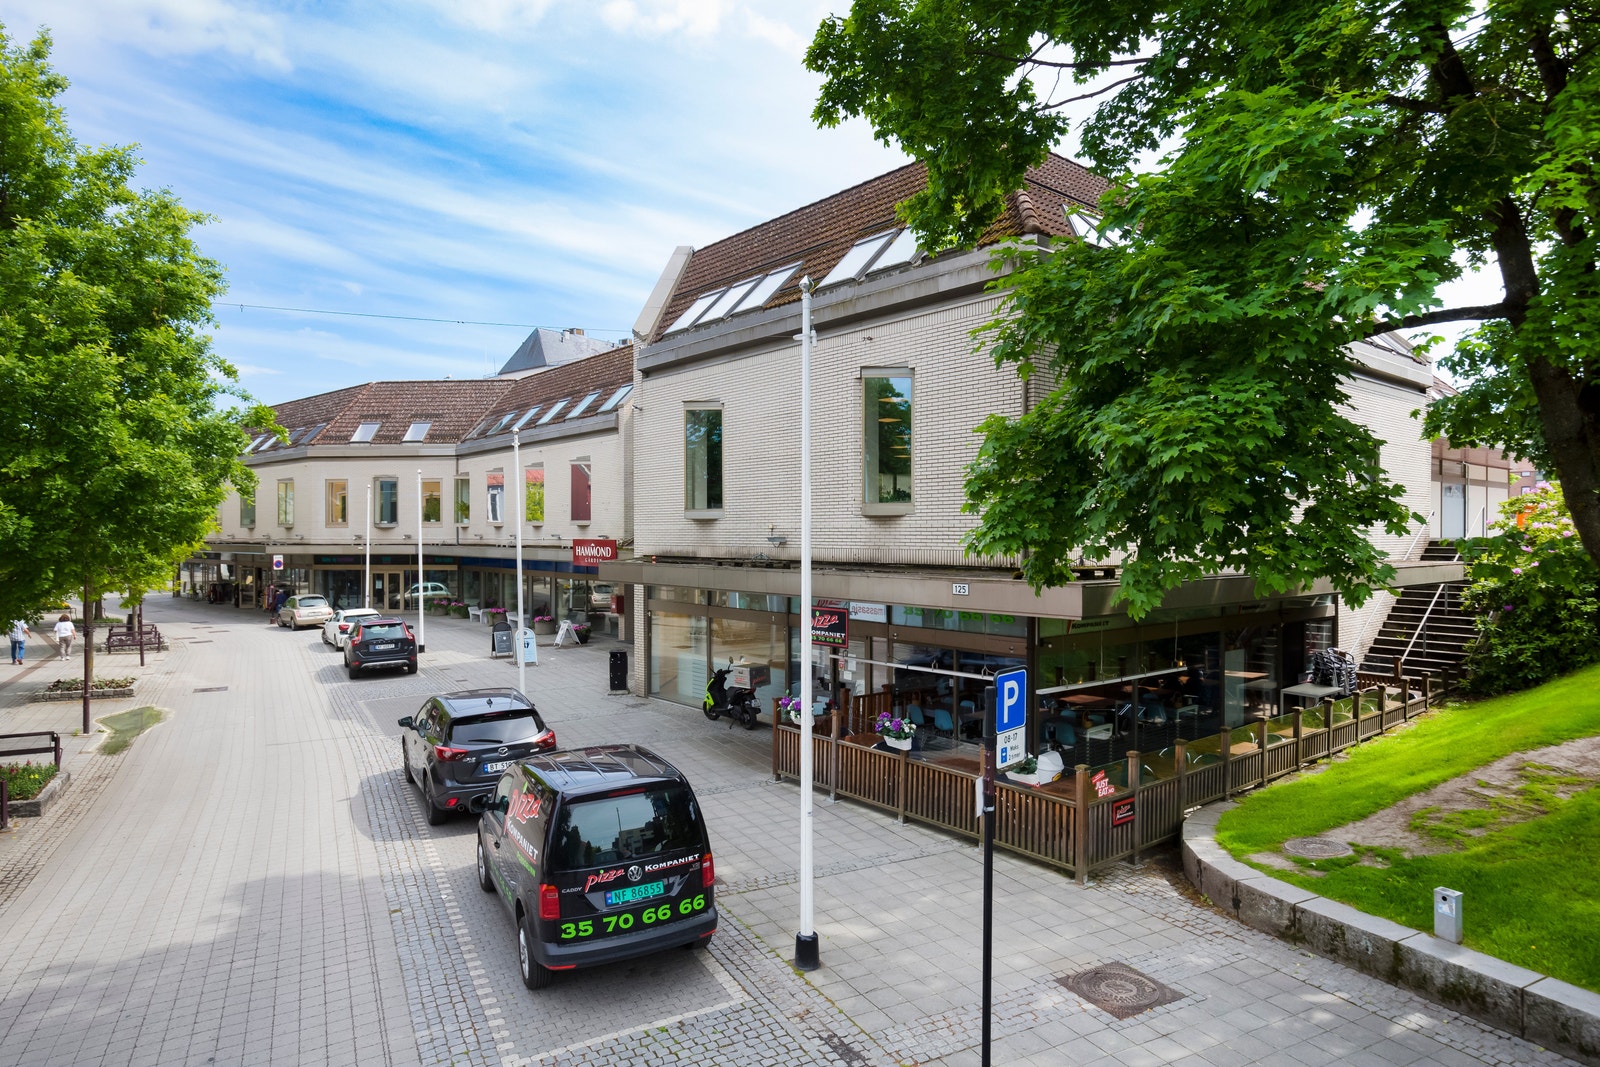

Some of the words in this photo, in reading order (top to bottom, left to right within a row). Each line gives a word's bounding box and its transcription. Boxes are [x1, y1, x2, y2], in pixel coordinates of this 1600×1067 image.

[575, 545, 612, 558] HAMMOND
[954, 585, 967, 594] 125
[811, 610, 840, 628] izza
[989, 613, 1016, 625] 66
[811, 629, 845, 638] OMPANIET
[1003, 680, 1019, 724] P
[1003, 732, 1018, 744] 08-17
[1094, 777, 1110, 790] JUST
[507, 819, 539, 861] KOMPANIET
[584, 869, 625, 893] pizza
[644, 853, 700, 871] KOMPANIET
[561, 886, 583, 894] CADDY
[614, 889, 627, 902] NF
[631, 883, 662, 899] 86855
[560, 919, 594, 940] 35
[602, 913, 634, 933] 70
[642, 904, 671, 925] 66
[679, 894, 706, 915] 66
